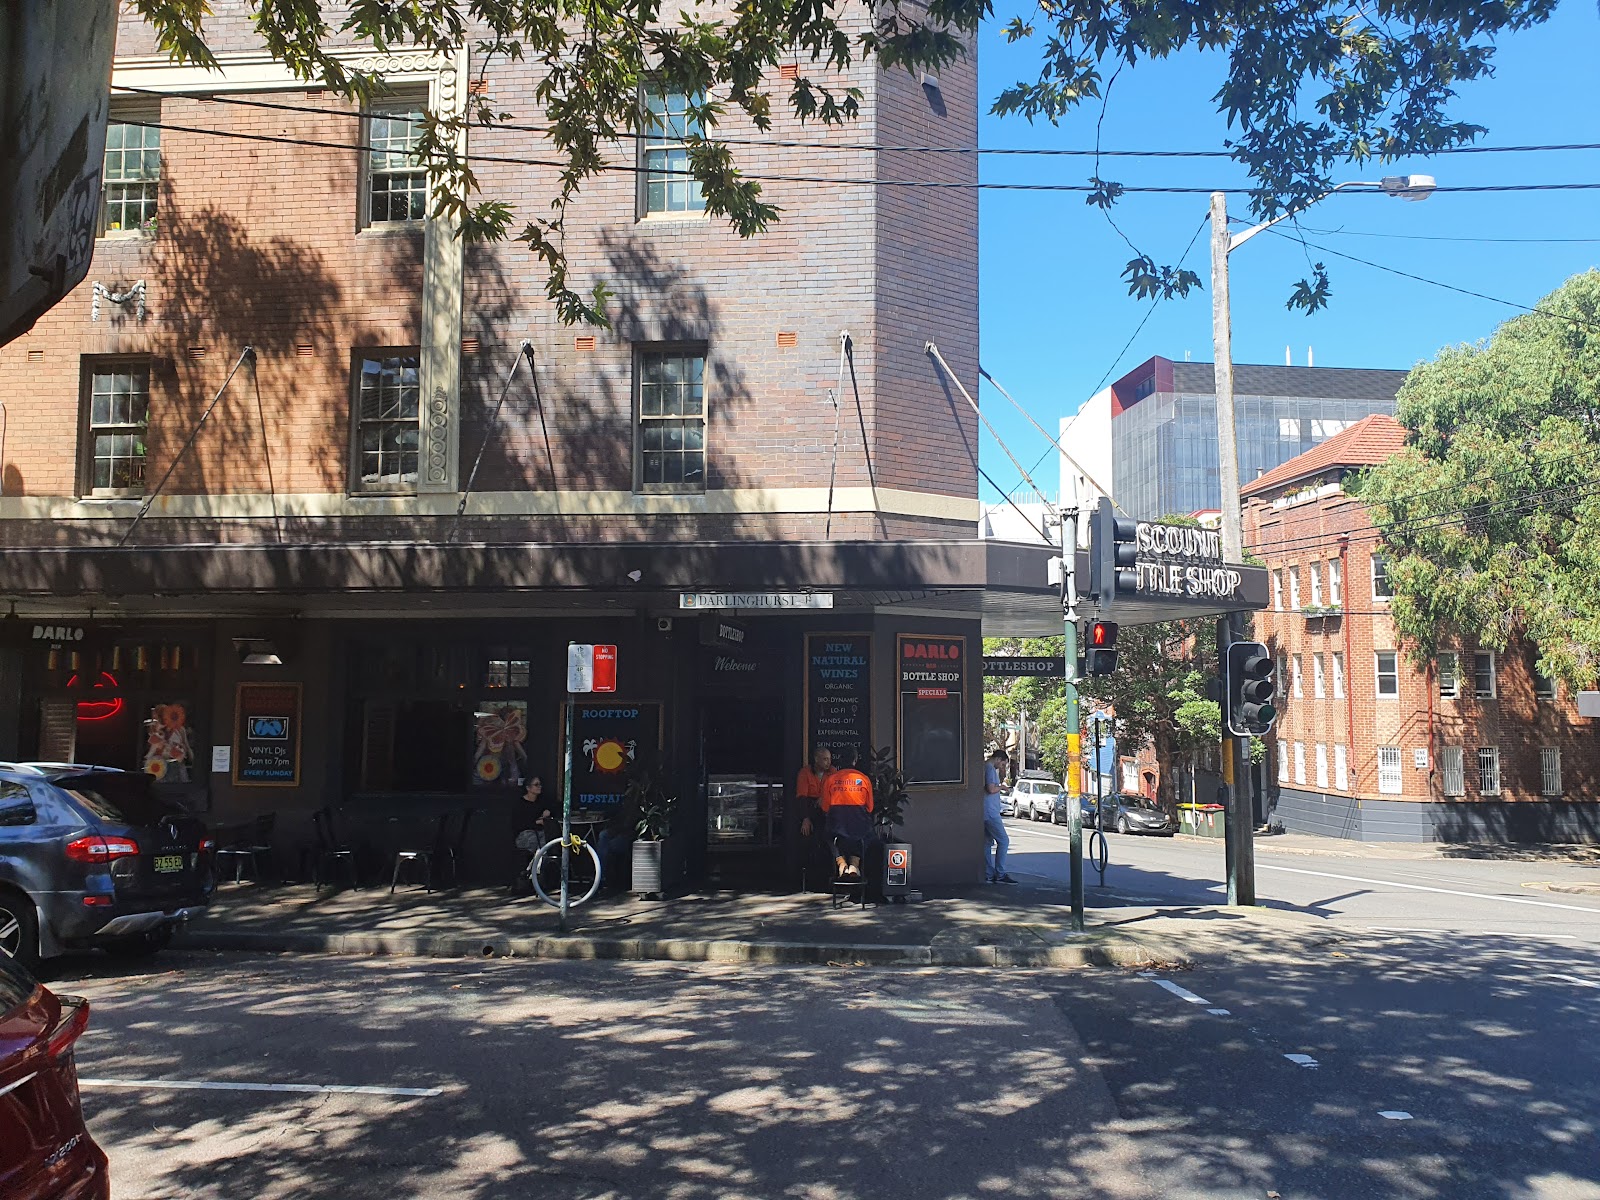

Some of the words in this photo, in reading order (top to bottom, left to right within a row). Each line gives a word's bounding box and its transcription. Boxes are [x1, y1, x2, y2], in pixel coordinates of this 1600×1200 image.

[1186, 566, 1241, 597] SHOP
[699, 595, 797, 606] DARLINGHURST
[32, 625, 84, 641] DARLO
[825, 643, 853, 652] NEW
[903, 643, 959, 659] DARLO
[714, 655, 757, 671] Welcome
[812, 656, 867, 665] NATURAL
[983, 661, 1054, 671] OTTLESHOP
[820, 669, 858, 678] WINES
[903, 671, 936, 681] BOTTLE
[937, 672, 960, 682] SHOP
[582, 709, 639, 718] ROOFTOP
[249, 746, 273, 755] VINYL
[274, 746, 287, 756] DJs
[247, 757, 264, 766] 3pm
[264, 757, 273, 765] to
[274, 757, 290, 766] 7pm
[265, 769, 293, 777] SUNDAY
[164, 857, 173, 868] 55
